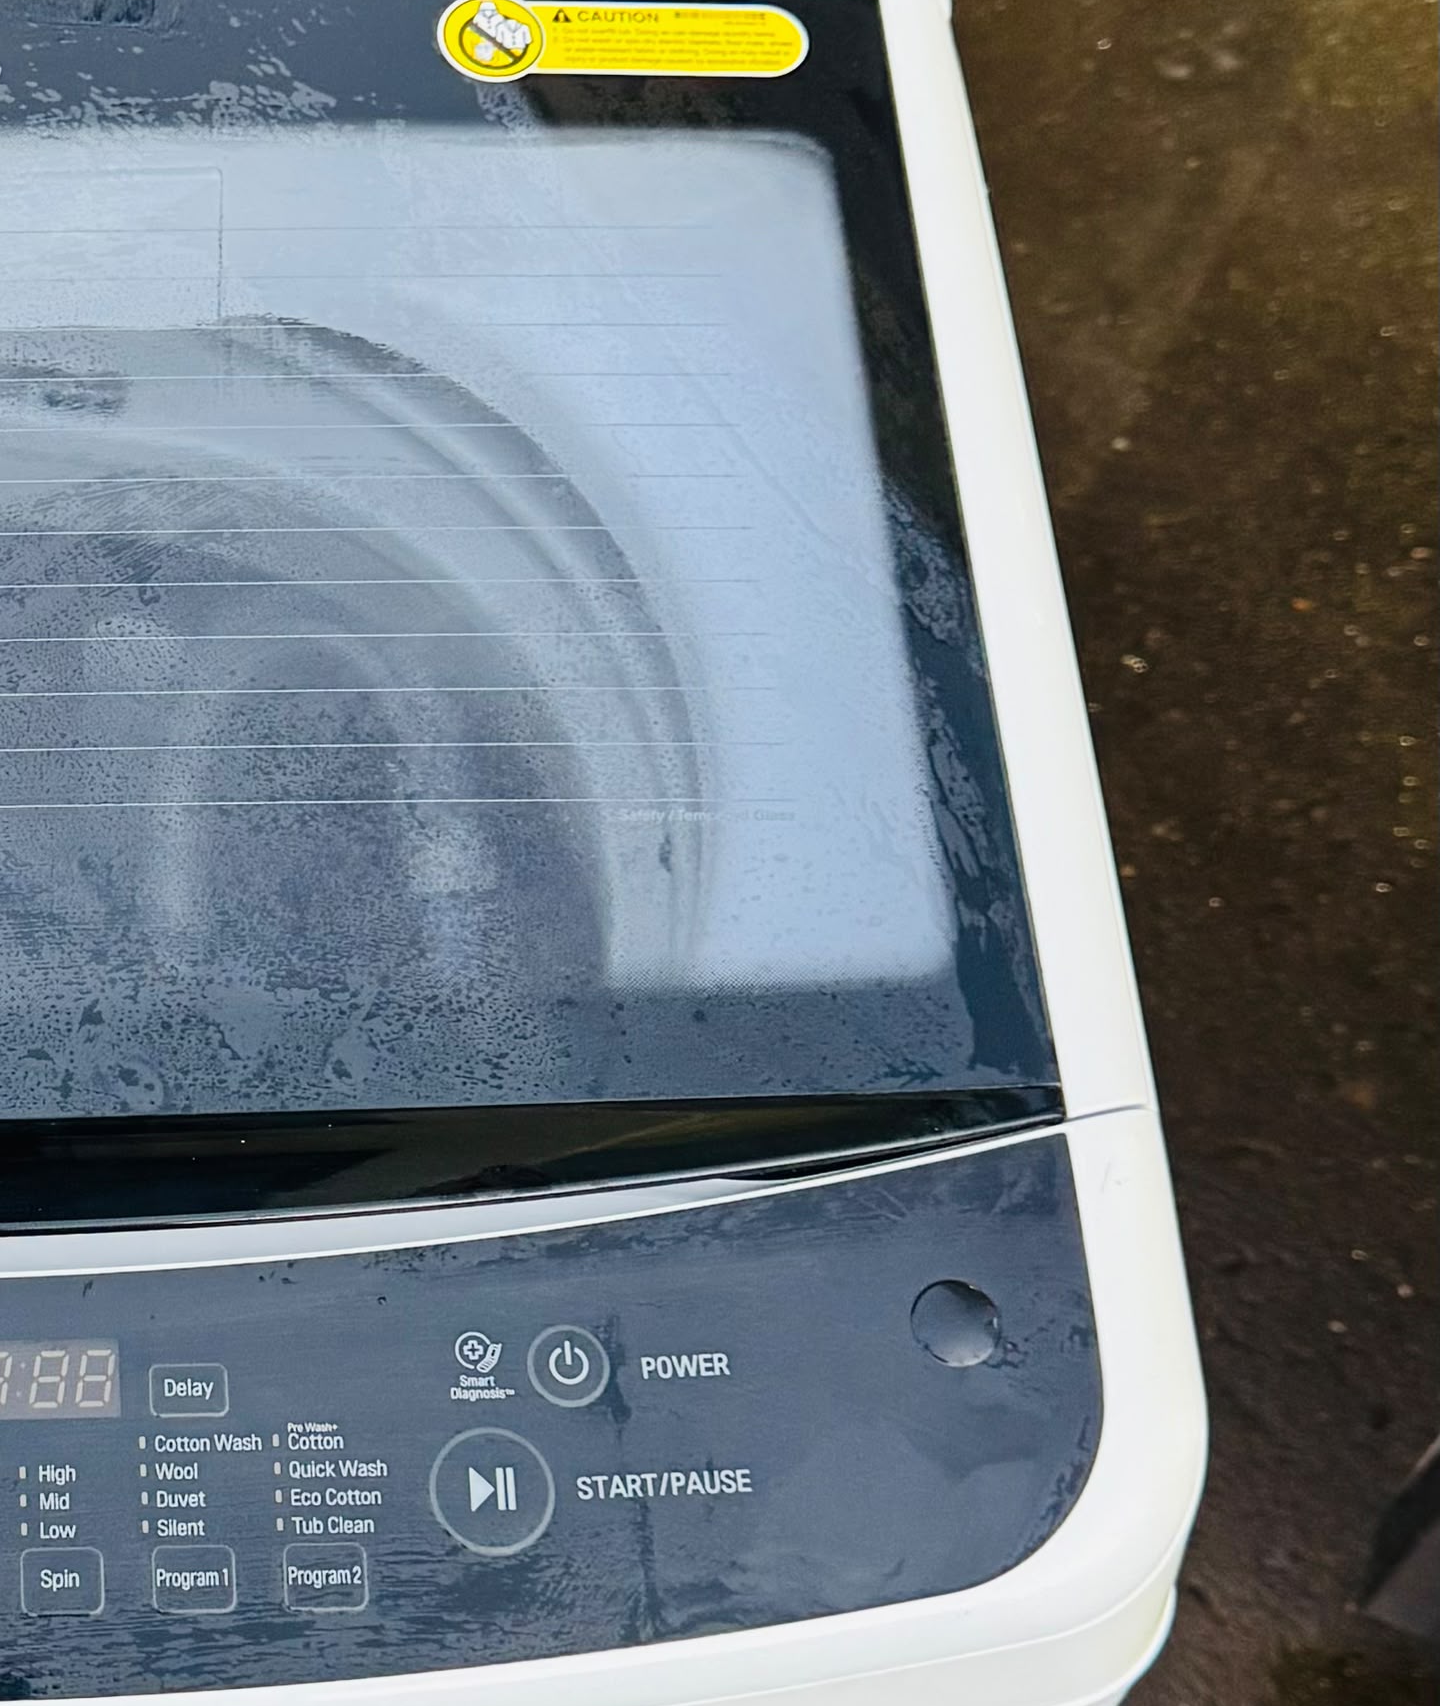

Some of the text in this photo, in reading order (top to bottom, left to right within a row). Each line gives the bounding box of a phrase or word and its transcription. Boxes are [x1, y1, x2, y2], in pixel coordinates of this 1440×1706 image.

[577, 10, 659, 23] CAUTION
[640, 1353, 731, 1380] POWER
[164, 1378, 214, 1400] Delay
[459, 1374, 495, 1387] Smart
[287, 1422, 303, 1433] Pre
[154, 1433, 262, 1452] Cotton Wash
[288, 1433, 344, 1451] Cotton
[38, 1465, 76, 1485] High
[155, 1462, 198, 1480] Wool
[288, 1459, 388, 1479] Quick Wash
[576, 1469, 753, 1500] START/PAUSE
[39, 1492, 70, 1510] Mid
[156, 1490, 206, 1508] Duvet
[290, 1488, 382, 1506] Eco Cotton
[39, 1521, 76, 1539] Low
[157, 1519, 205, 1537] Silent
[291, 1516, 375, 1534] Tub Clean
[40, 1569, 80, 1592] Spin
[156, 1567, 220, 1591] Program
[288, 1565, 362, 1589] Program 2
